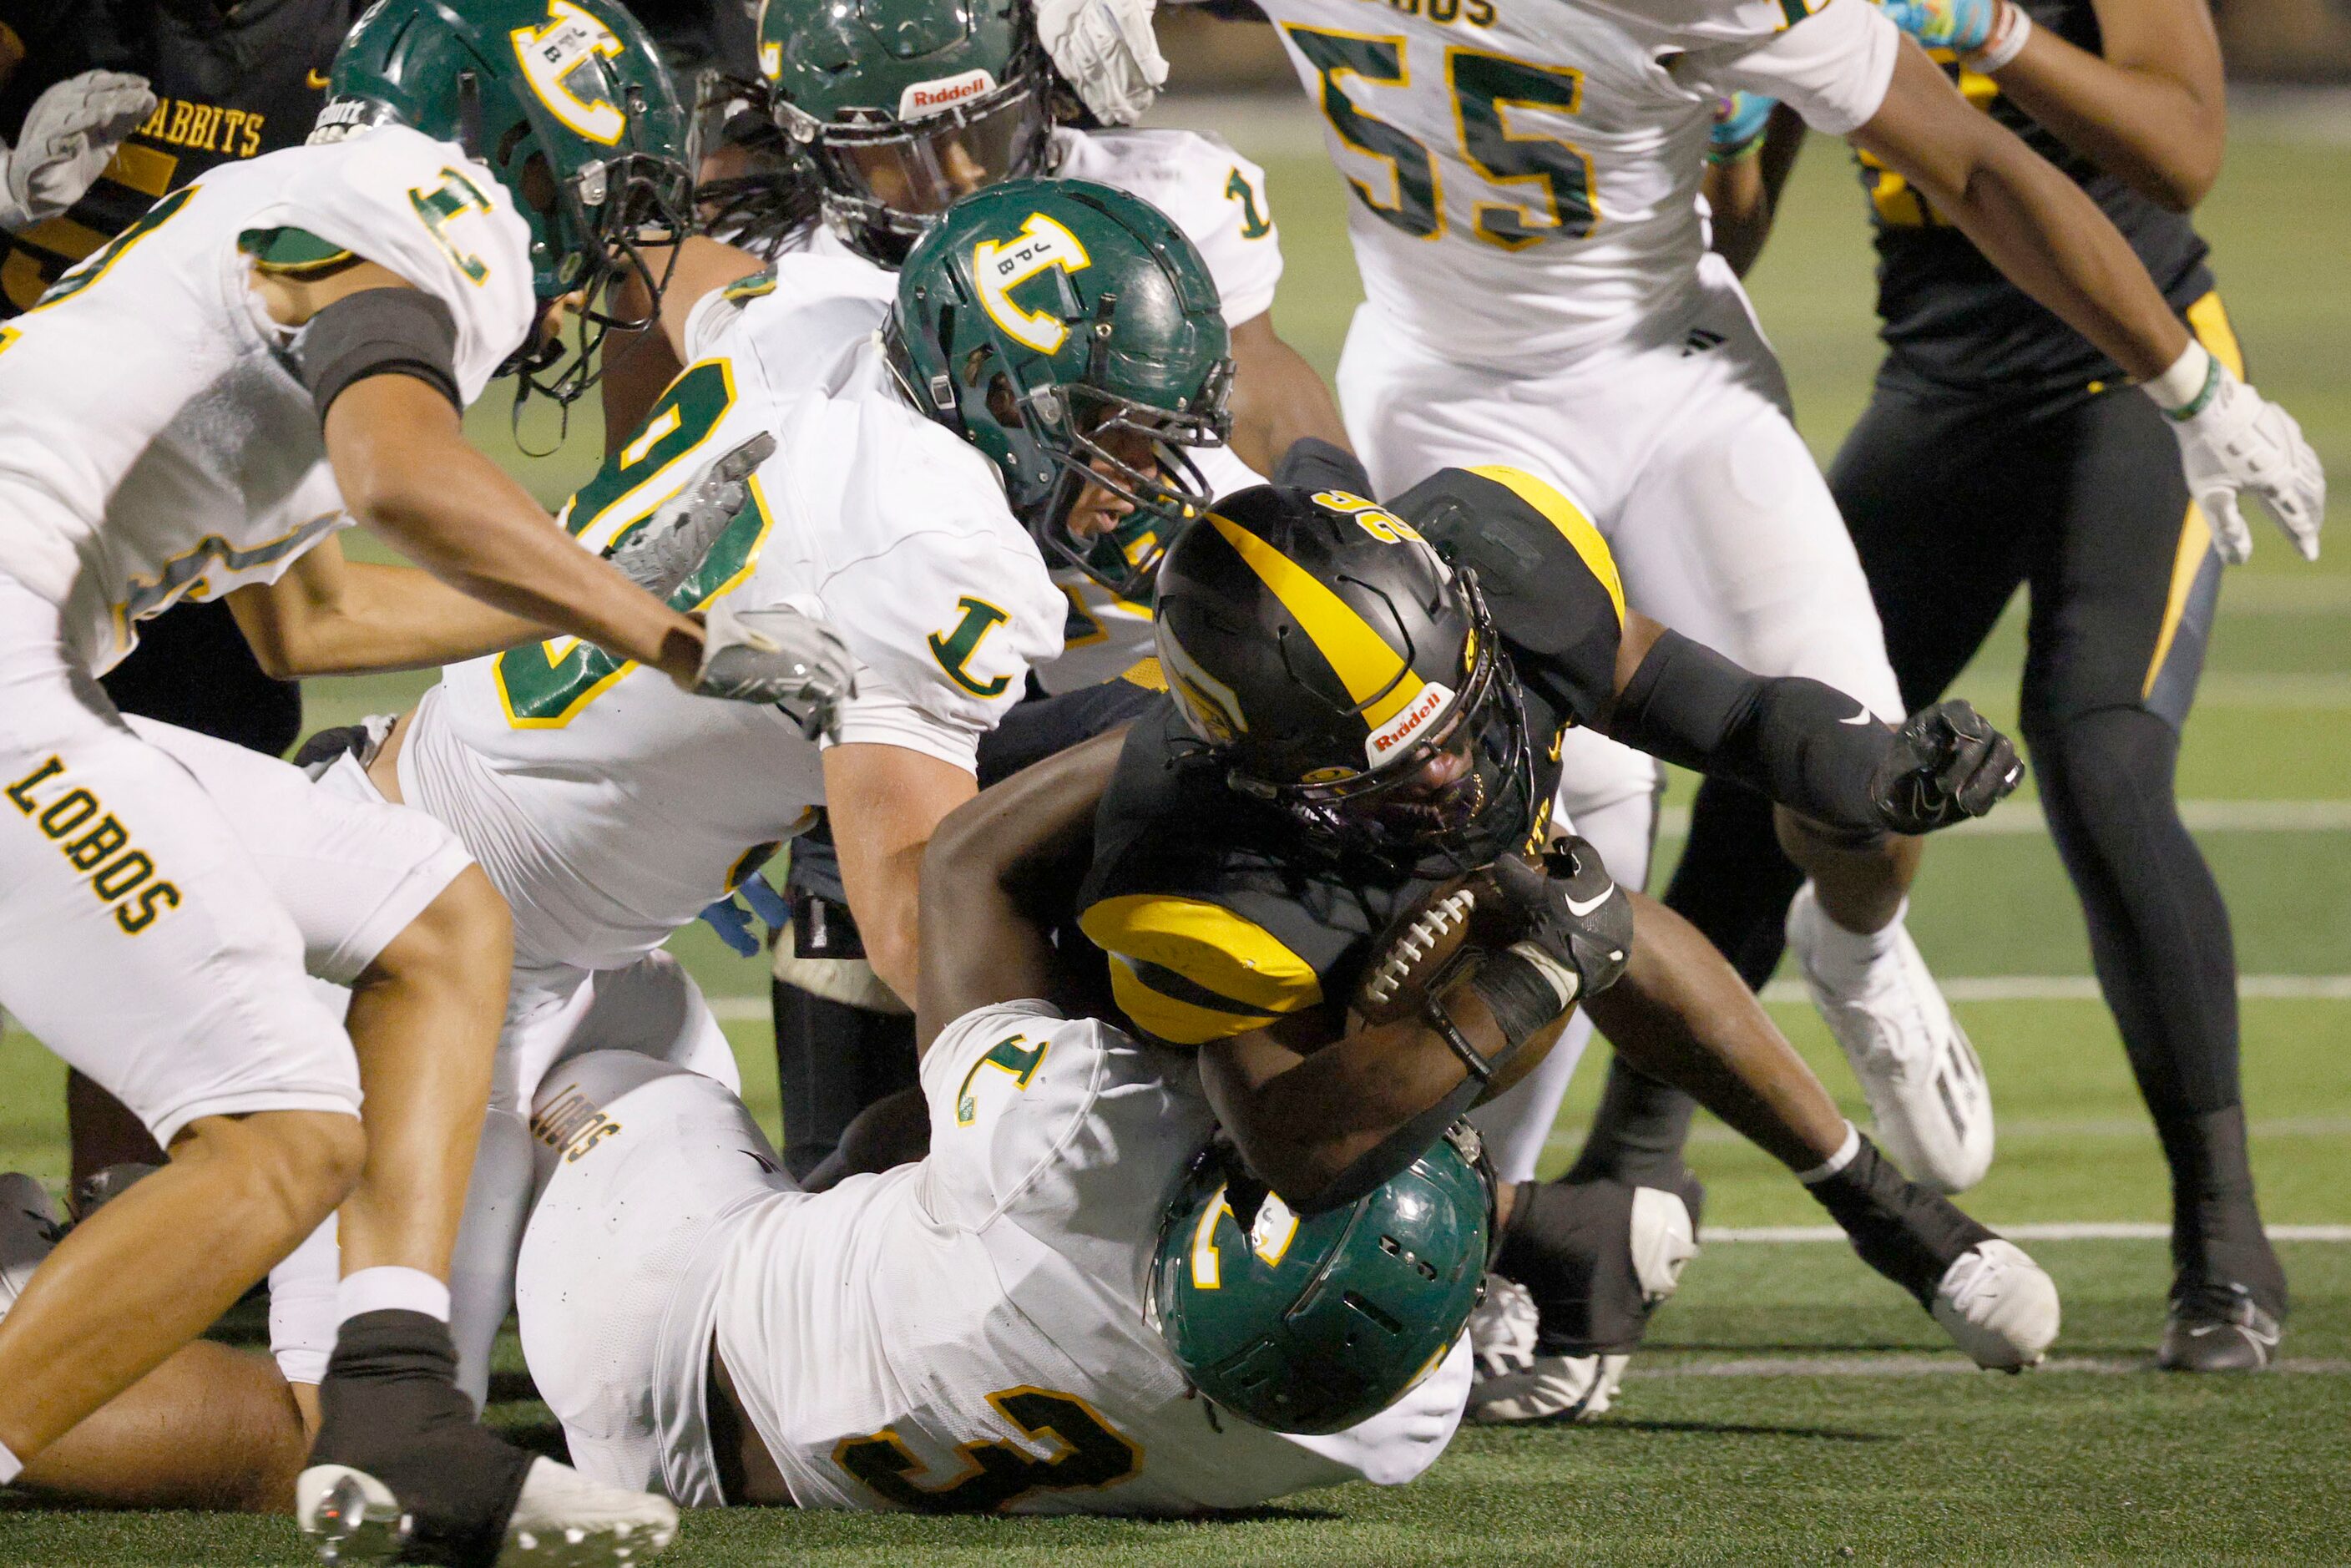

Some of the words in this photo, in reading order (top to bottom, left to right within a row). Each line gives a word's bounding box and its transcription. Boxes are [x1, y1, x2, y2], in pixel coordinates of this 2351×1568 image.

[913, 78, 984, 107] Riddell
[135, 97, 265, 157] ABBITS
[1279, 20, 1602, 251] 55
[997, 242, 1052, 276] JPB
[1373, 692, 1441, 753] Riddell
[5, 754, 182, 935] LOBOS
